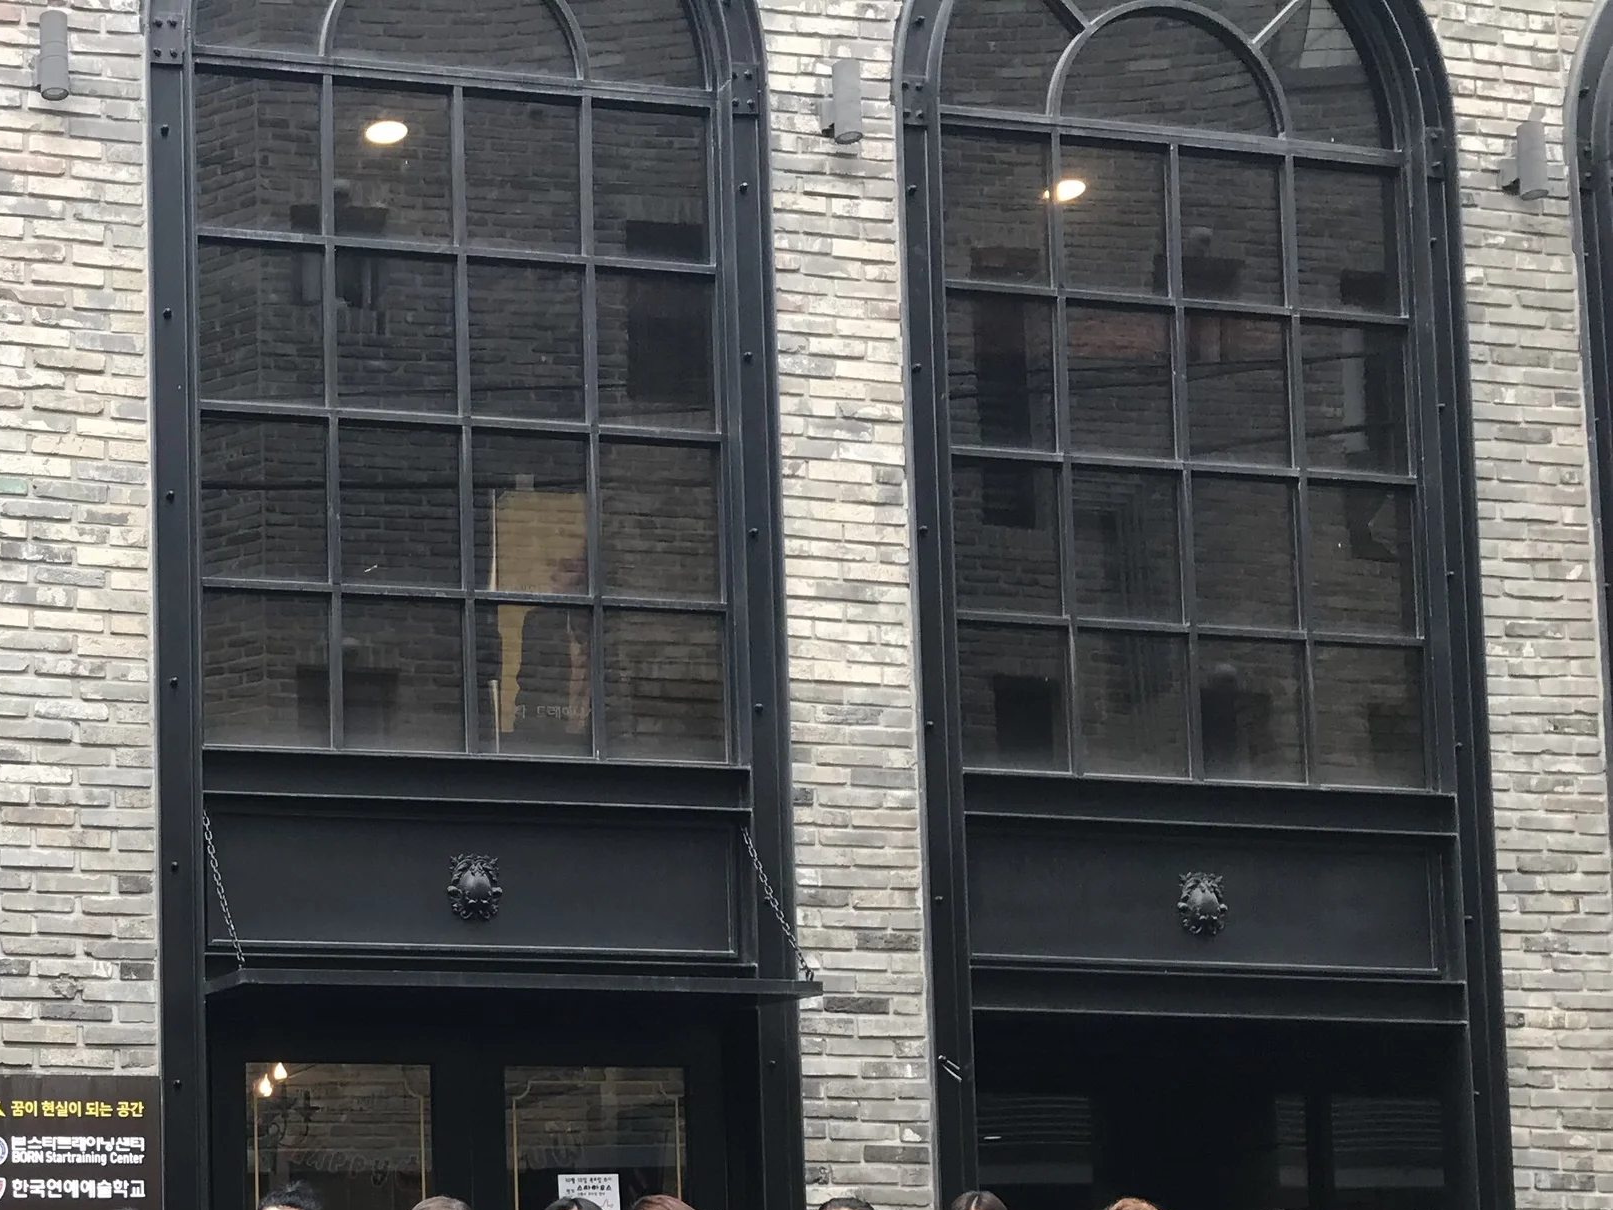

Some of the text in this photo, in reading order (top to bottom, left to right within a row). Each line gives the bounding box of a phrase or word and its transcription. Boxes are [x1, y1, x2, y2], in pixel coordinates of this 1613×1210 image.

[10, 1100, 144, 1118] 꿈이 현실이 되는 공간
[11, 1151, 144, 1166] BORN Startraining Center
[11, 1178, 146, 1198] 한국연예예술학교
